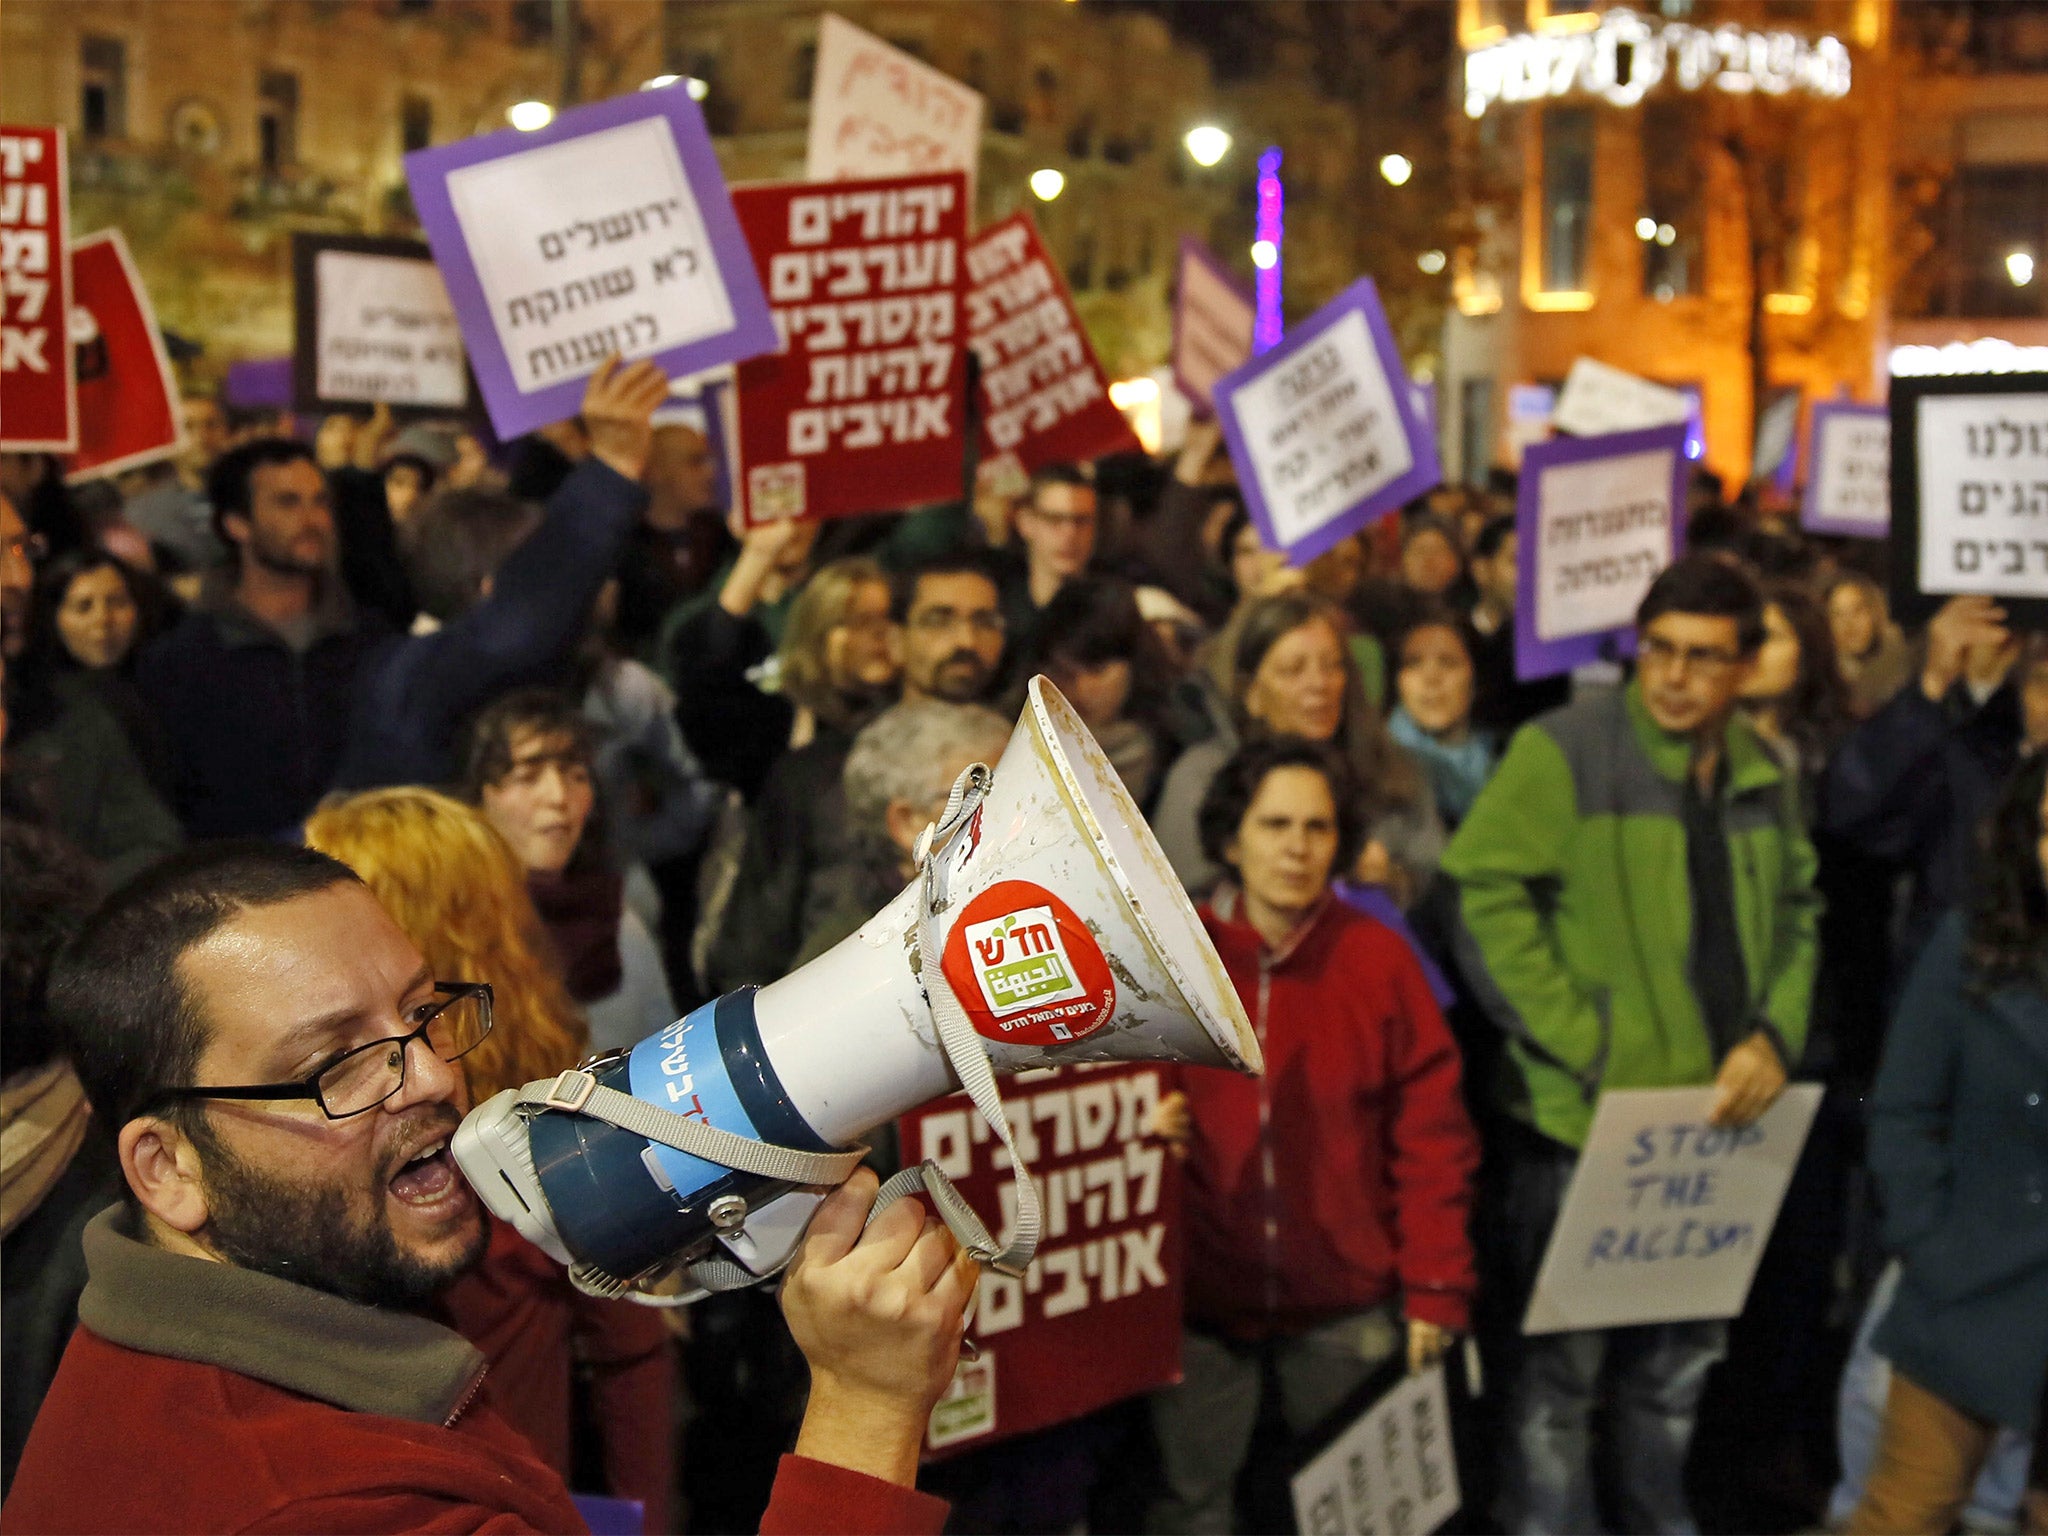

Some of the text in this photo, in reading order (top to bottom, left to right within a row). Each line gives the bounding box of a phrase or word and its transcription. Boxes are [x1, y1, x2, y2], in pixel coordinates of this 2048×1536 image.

[537, 198, 680, 263] ירושלים
[788, 183, 955, 247] יהודים
[507, 247, 698, 329] לא שותקת
[769, 238, 957, 300] וערבים
[806, 335, 955, 402] להיות
[787, 394, 951, 457] אויבים
[1966, 418, 2048, 459] ולנו
[1954, 539, 2048, 577] רבים
[989, 957, 1063, 998] الجبهة
[999, 1016, 1030, 1032] חדש
[1027, 1007, 1065, 1025] שמאל
[920, 1069, 1160, 1181] מסרבים
[1626, 1123, 1766, 1167] STOP
[995, 1140, 1165, 1248] להיות
[1628, 1169, 1715, 1210] THE
[1584, 1219, 1753, 1268] RACISM
[977, 1222, 1168, 1337] אויבים
